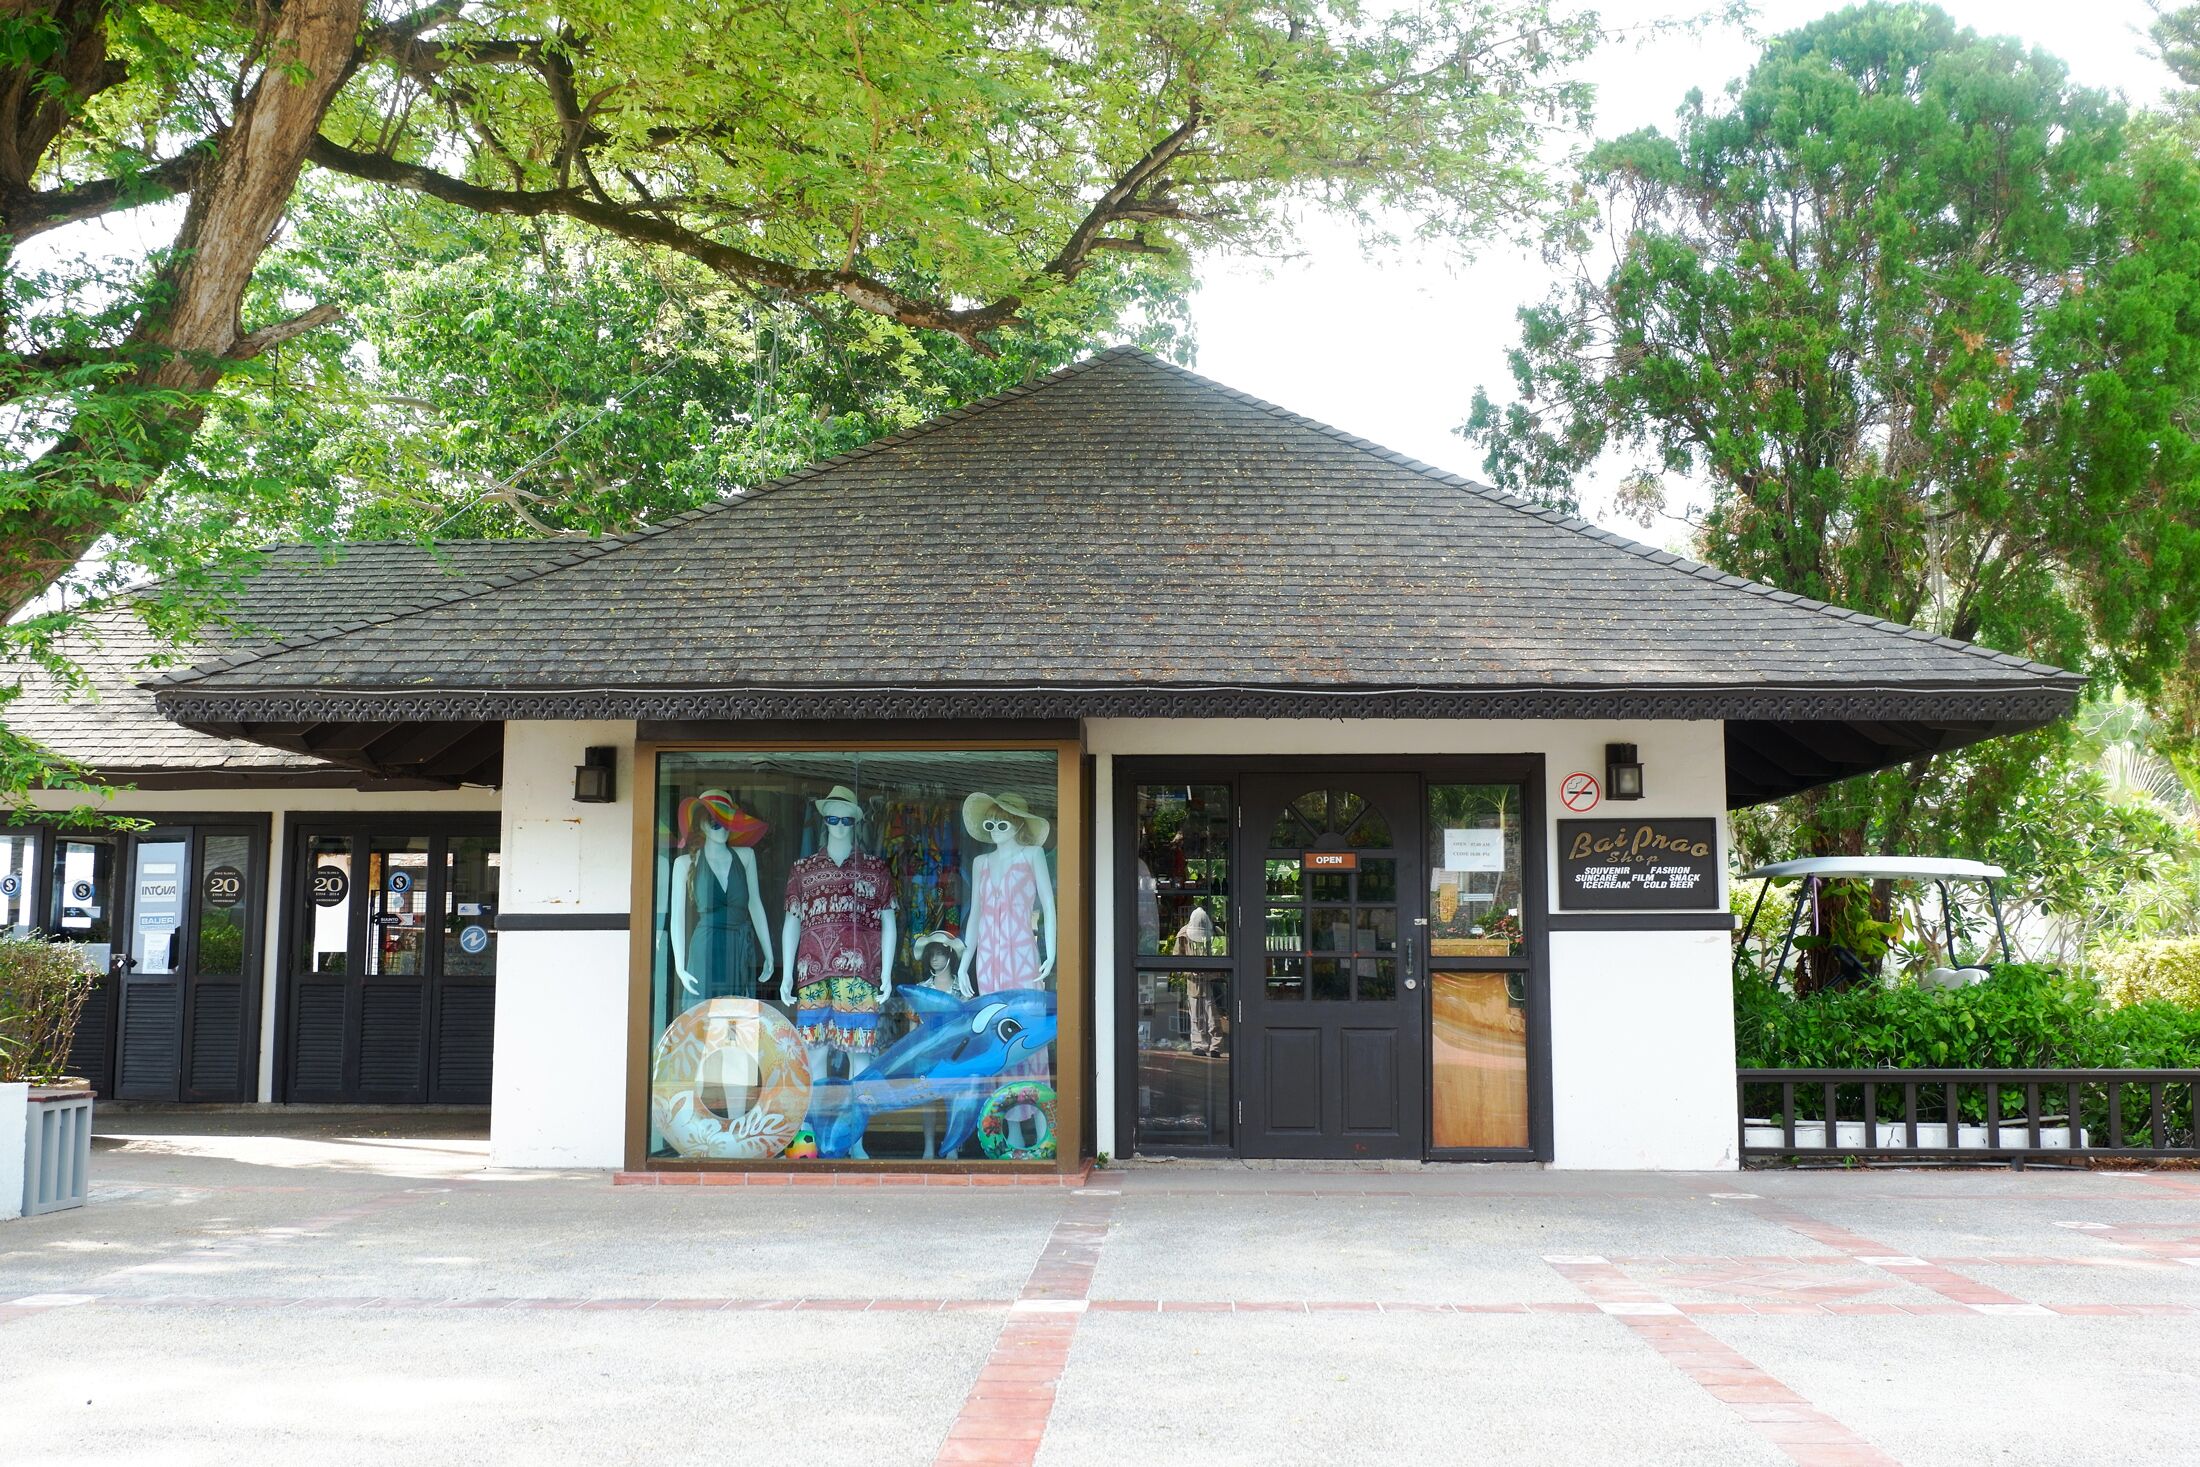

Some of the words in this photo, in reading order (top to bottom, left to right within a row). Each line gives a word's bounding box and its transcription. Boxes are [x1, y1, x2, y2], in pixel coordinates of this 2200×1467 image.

[1568, 828, 1629, 860] Bai
[1631, 825, 1709, 857] Prao
[1315, 856, 1343, 864] OPEN
[1606, 850, 1661, 866] Shop
[1584, 866, 1630, 875] SOUVENIR
[1650, 866, 1691, 875] FASHION
[1575, 873, 1618, 882] SUNCARE
[1631, 873, 1655, 882] FILM
[1668, 873, 1700, 882] SNACK
[1582, 881, 1631, 889] ICECREAM
[1643, 881, 1667, 889] COLD
[1669, 881, 1695, 889] BEER
[141, 885, 176, 896] INTOVA
[141, 916, 174, 925] BAUER
